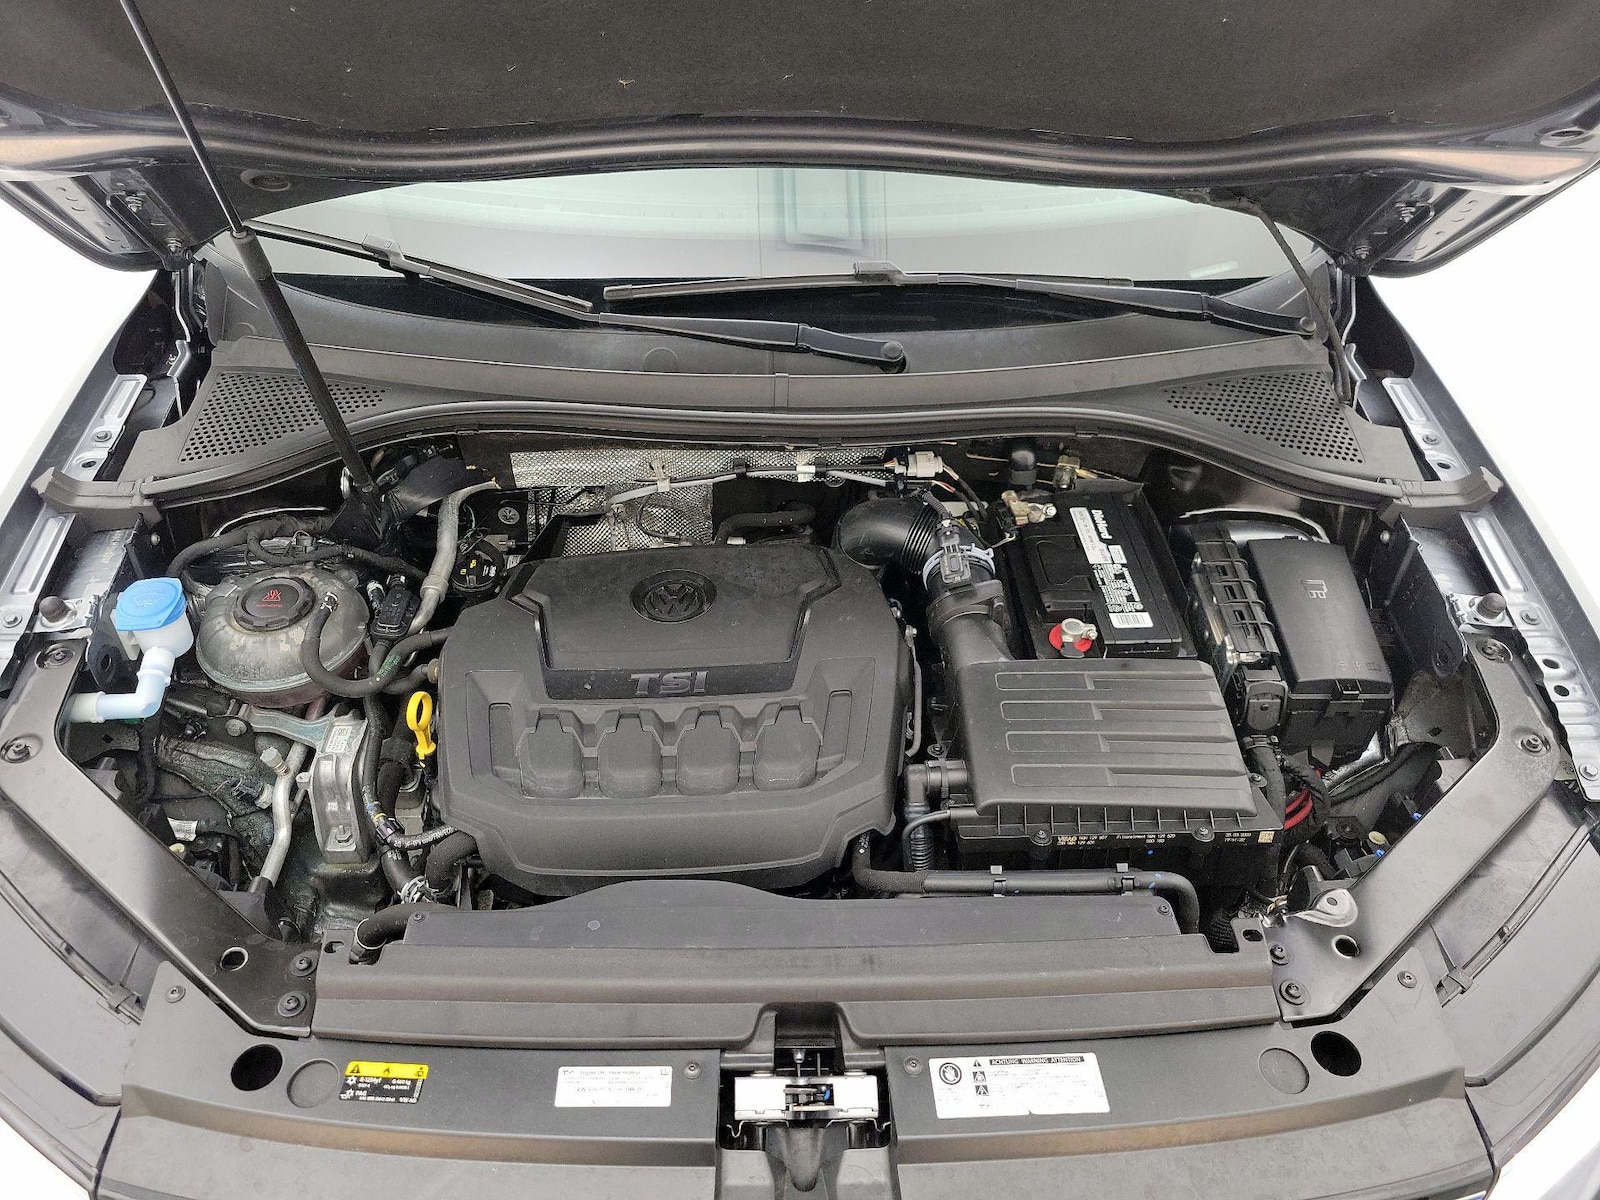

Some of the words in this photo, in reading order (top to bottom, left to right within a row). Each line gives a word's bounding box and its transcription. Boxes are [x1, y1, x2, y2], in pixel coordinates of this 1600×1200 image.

[1091, 509, 1112, 539] DieHard
[630, 670, 709, 695] TSI
[991, 1058, 1020, 1066] ACHTUNG
[1021, 1057, 1049, 1065] WARNING
